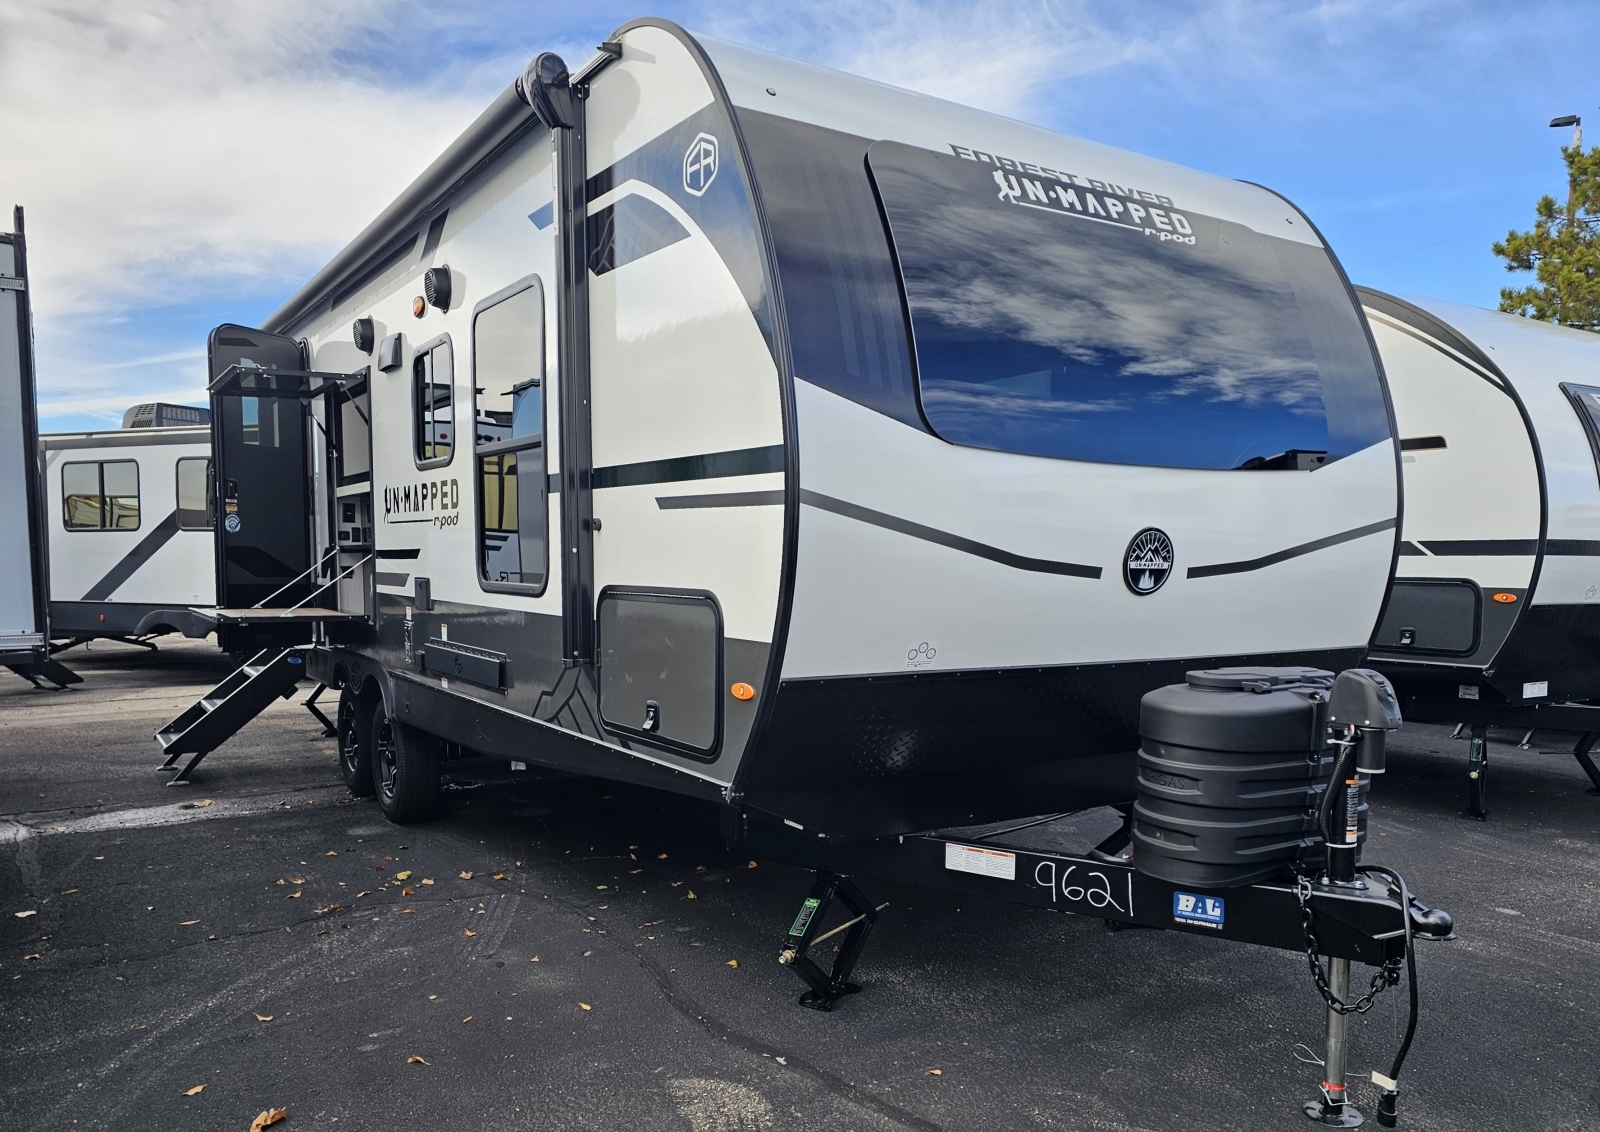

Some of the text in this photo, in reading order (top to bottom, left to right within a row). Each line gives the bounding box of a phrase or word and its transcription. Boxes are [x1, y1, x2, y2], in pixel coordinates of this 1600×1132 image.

[948, 143, 1175, 207] FOREST RIVER
[1158, 774, 1185, 790] GAS
[1035, 861, 1134, 917] 9621
